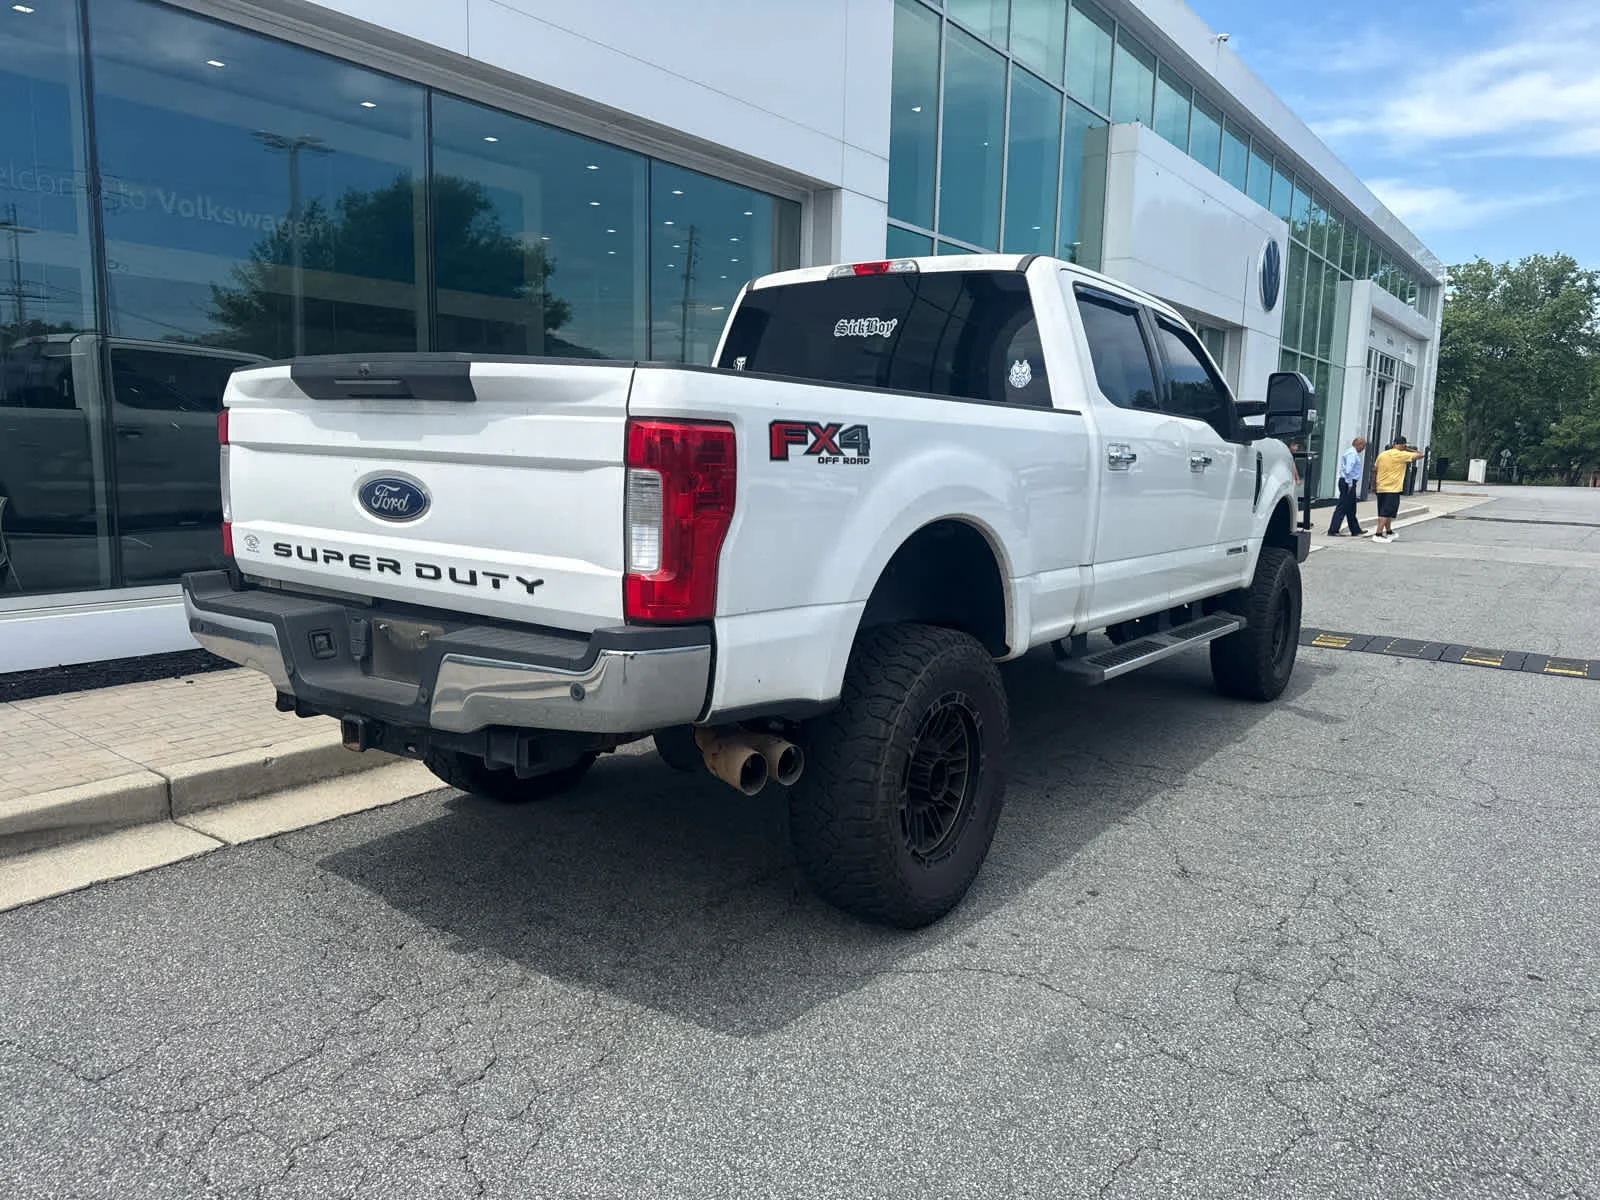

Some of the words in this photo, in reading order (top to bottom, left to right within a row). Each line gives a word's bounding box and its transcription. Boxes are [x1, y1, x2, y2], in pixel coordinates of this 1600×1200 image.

[119, 182, 147, 209] to
[769, 419, 871, 461] FX4
[371, 484, 410, 512] Ford
[272, 541, 402, 576] SUPER
[414, 562, 545, 595] DUTY
